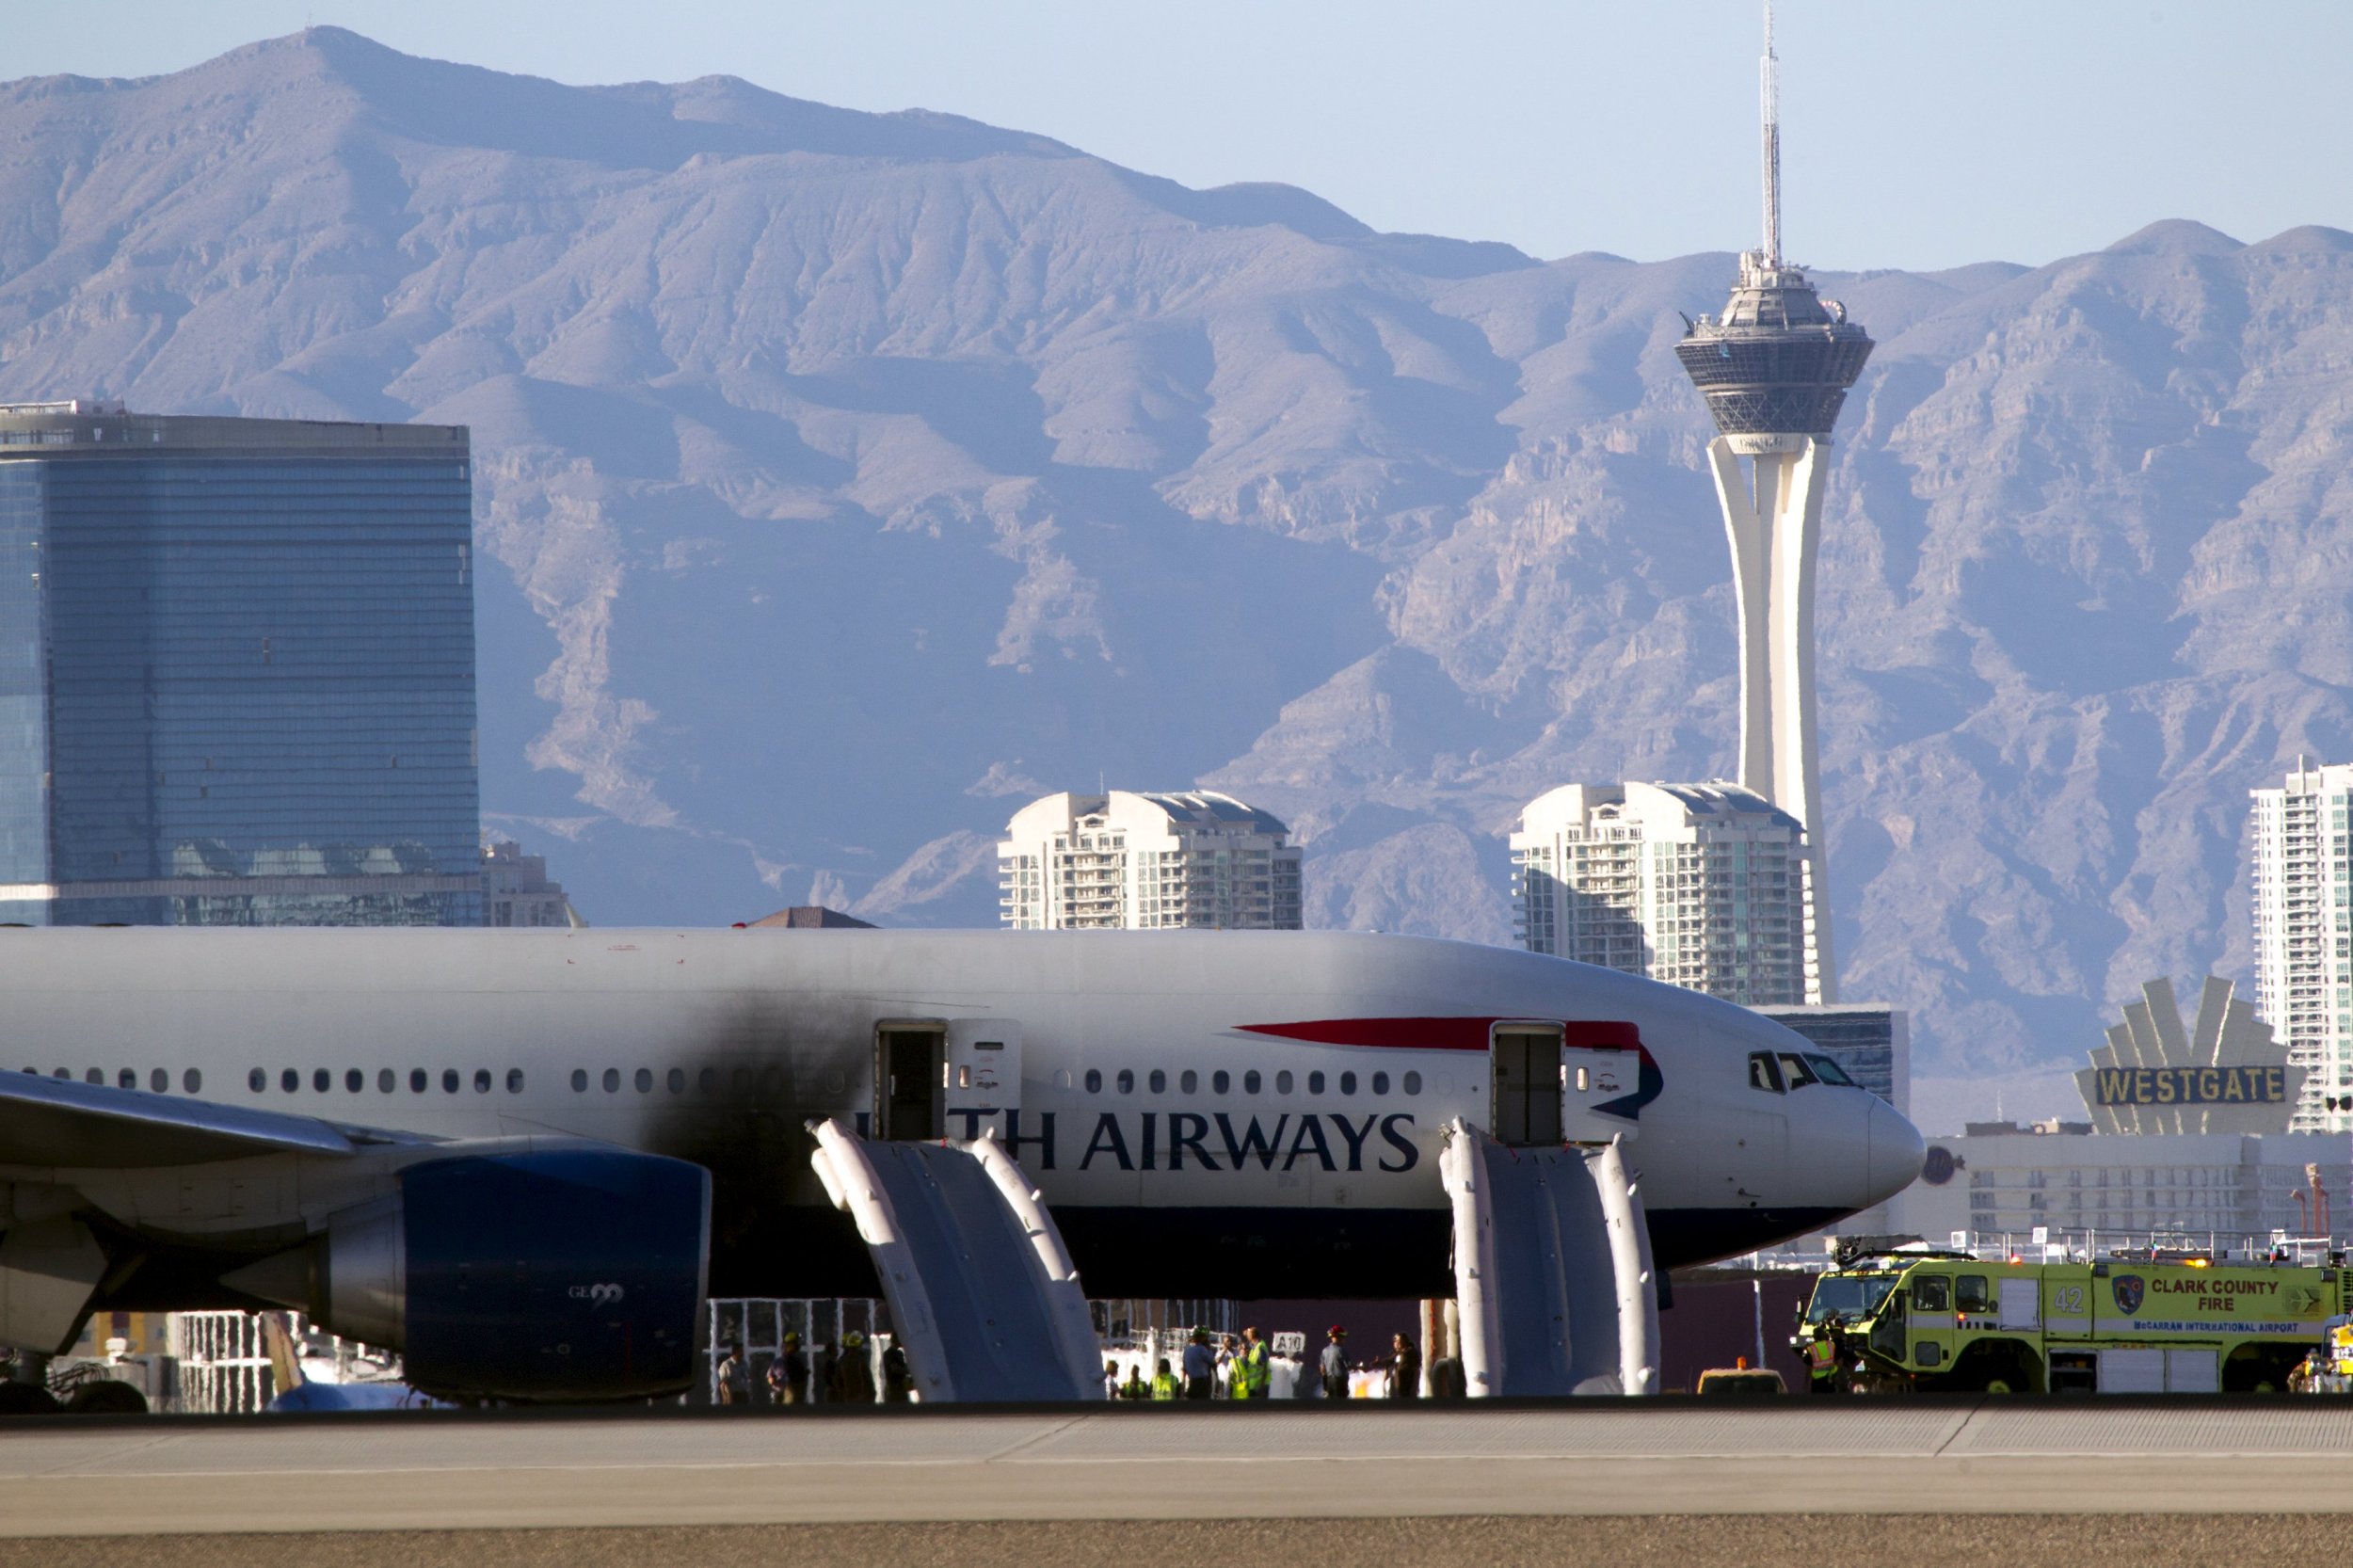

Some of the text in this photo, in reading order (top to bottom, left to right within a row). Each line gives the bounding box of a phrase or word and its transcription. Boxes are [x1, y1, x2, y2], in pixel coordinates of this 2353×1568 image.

[2099, 1068, 2283, 1103] WESTGATE
[1078, 1112, 1419, 1173] AIRWAYS
[2152, 1279, 2279, 1295] CLARK COUNTY
[2054, 1287, 2084, 1314] 42
[2198, 1297, 2234, 1311] FIRE
[2185, 1321, 2256, 1333] INTERNATIONAL
[2259, 1322, 2298, 1333] AIRPORT
